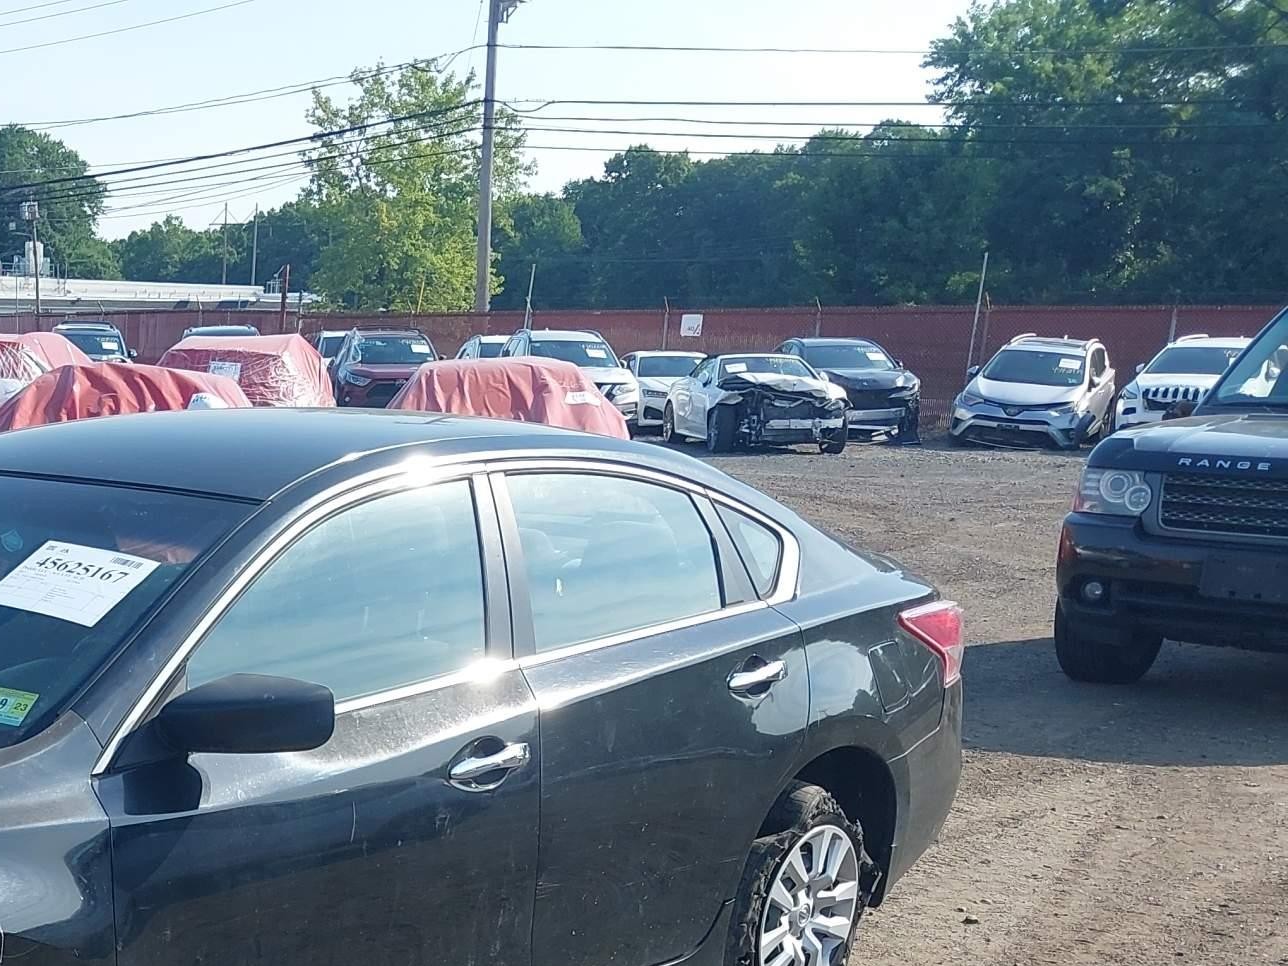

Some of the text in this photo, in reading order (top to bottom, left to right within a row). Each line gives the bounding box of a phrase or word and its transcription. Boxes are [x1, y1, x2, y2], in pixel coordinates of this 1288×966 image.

[1178, 457, 1271, 470] RANGE
[36, 556, 130, 584] 45625167
[14, 702, 28, 712] 23
